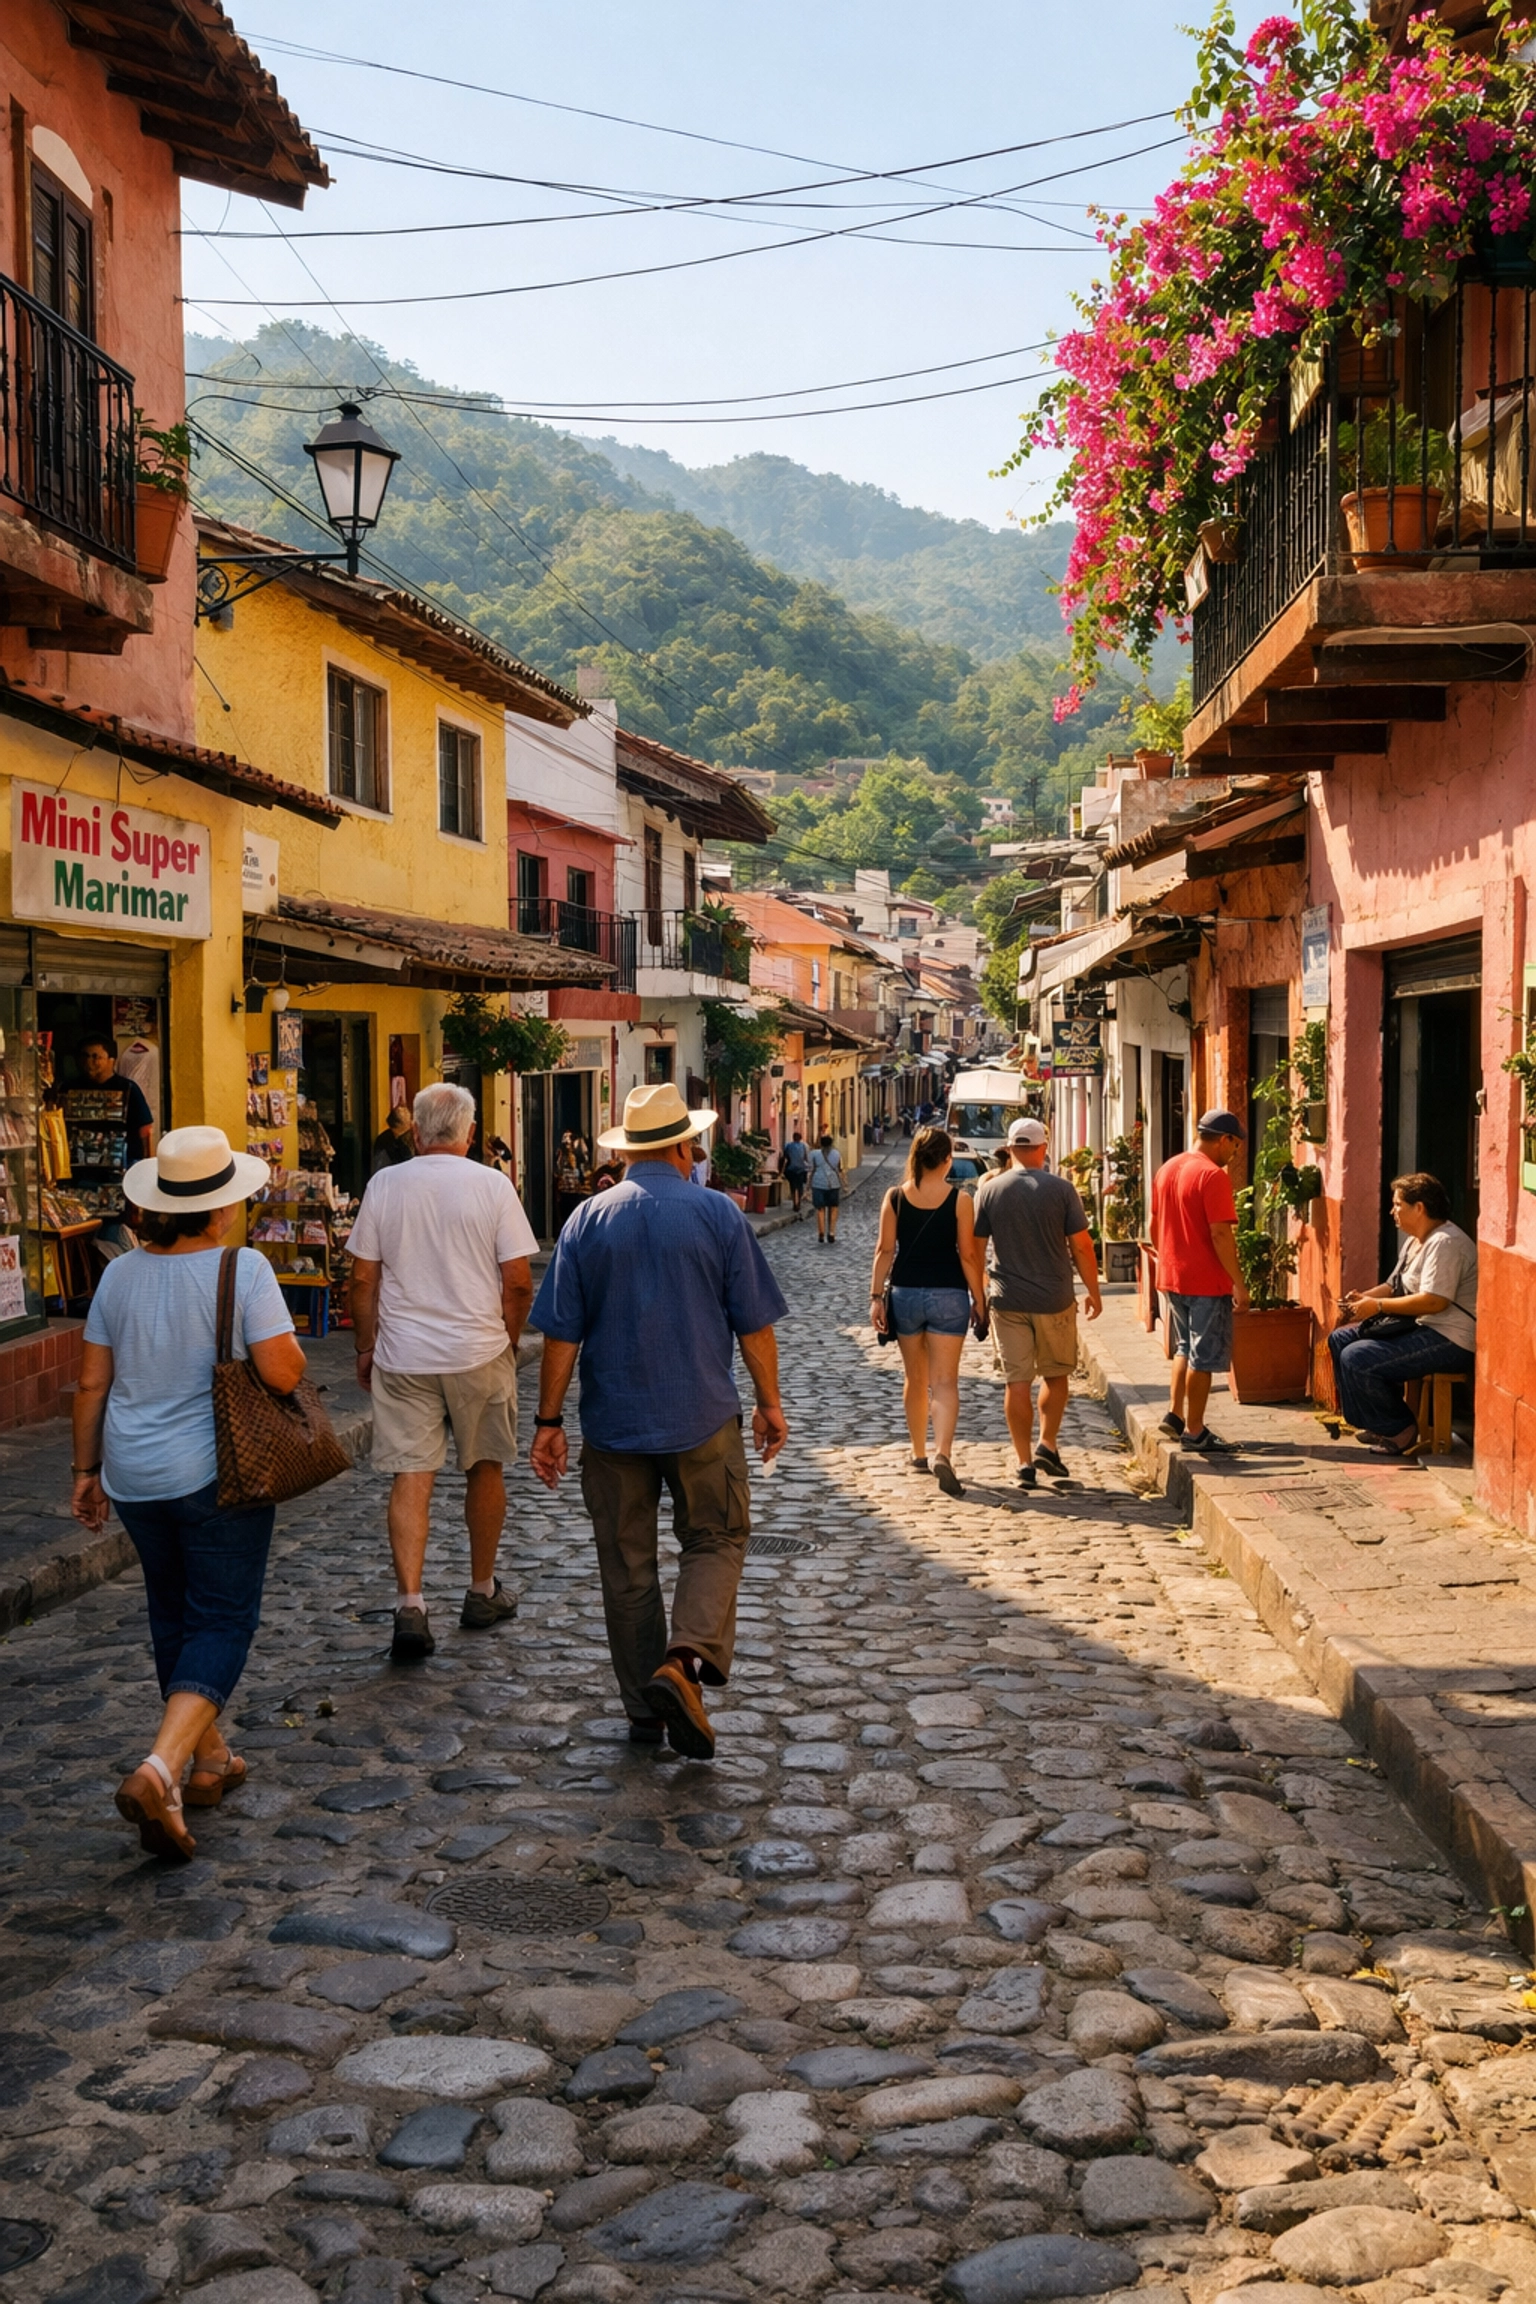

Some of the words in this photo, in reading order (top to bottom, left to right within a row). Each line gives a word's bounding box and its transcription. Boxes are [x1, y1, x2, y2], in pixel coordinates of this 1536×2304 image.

[21, 791, 101, 856] Mini
[111, 811, 200, 878] Super
[55, 861, 188, 921] Marimar
